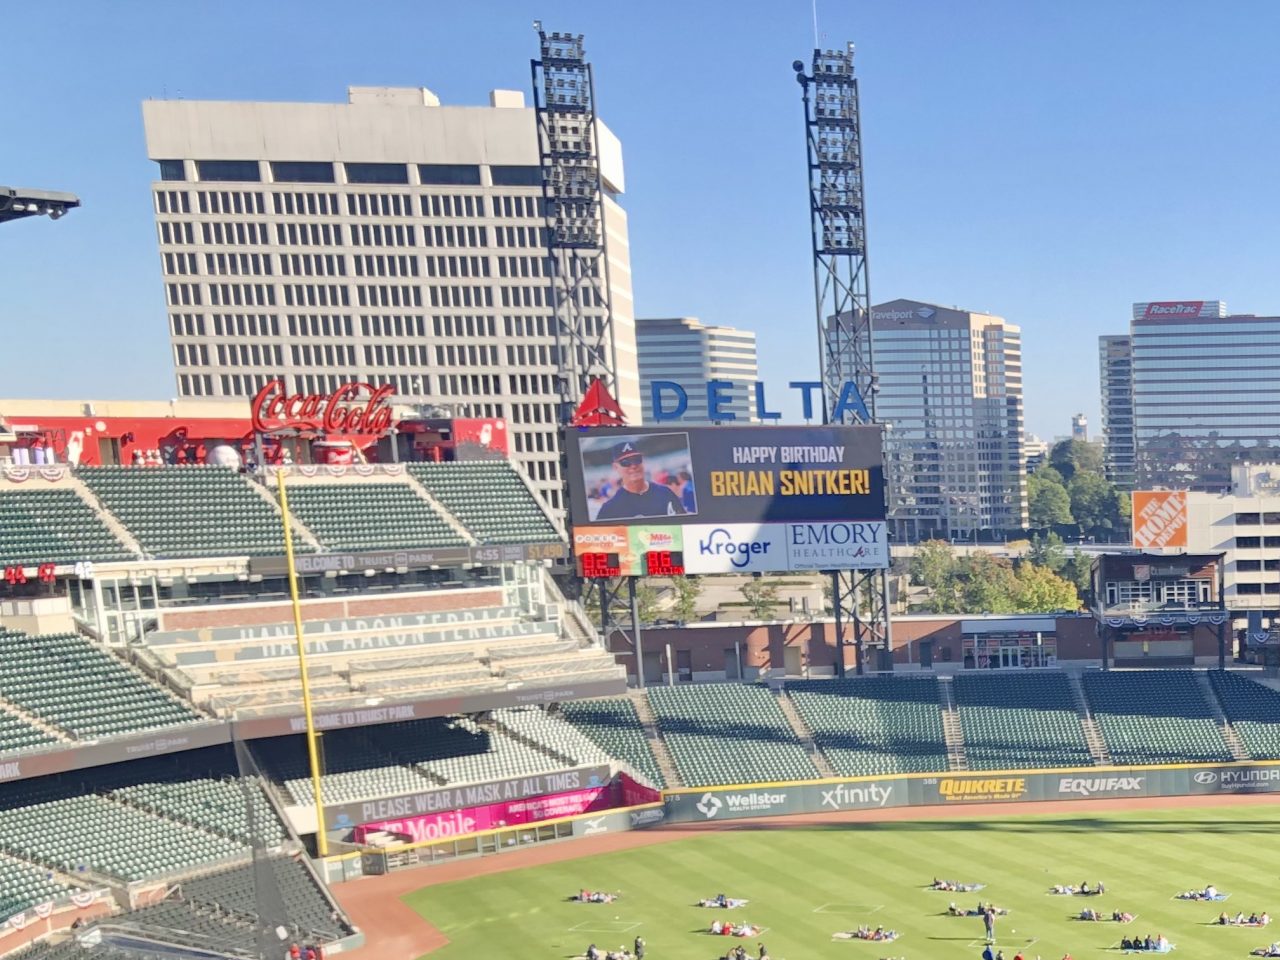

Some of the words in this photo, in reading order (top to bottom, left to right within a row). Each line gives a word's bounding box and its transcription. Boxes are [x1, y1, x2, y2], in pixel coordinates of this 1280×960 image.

[1150, 304, 1197, 314] RaceTrac
[650, 381, 871, 421] DELTA
[732, 446, 777, 464] HAPPY
[781, 446, 845, 463] BIRTHDAY
[711, 471, 774, 496] BRIAN
[780, 469, 871, 496] SNITKER!
[1135, 492, 1187, 548] HOME
[1139, 497, 1159, 520] THE
[792, 523, 882, 545] EMORY
[1155, 513, 1187, 548] DEPOT
[475, 549, 499, 561] 4:55
[700, 528, 771, 568] Kroger
[794, 545, 880, 558] HEALTHCARE
[339, 556, 354, 570] TO
[358, 556, 393, 566] TRUIST
[408, 553, 434, 563] PARK
[323, 617, 426, 650] AARON
[416, 608, 542, 641] TERRACE
[290, 714, 341, 731] WECOME
[342, 713, 353, 725] TO
[353, 709, 388, 723] TRUIST
[389, 705, 414, 718] PARK
[362, 800, 412, 821] PLEASE
[416, 795, 451, 812] WEAR
[456, 793, 464, 807] A
[466, 787, 501, 806] MASK
[504, 783, 520, 798] AT
[522, 779, 544, 796] ALL
[546, 772, 580, 790] TIMES
[822, 783, 893, 810] xfinity
[940, 778, 1025, 795] QUIKRETE
[1058, 777, 1143, 796] EQUIFAX
[726, 793, 786, 807] Wellstar
[407, 813, 475, 842] Mobile
